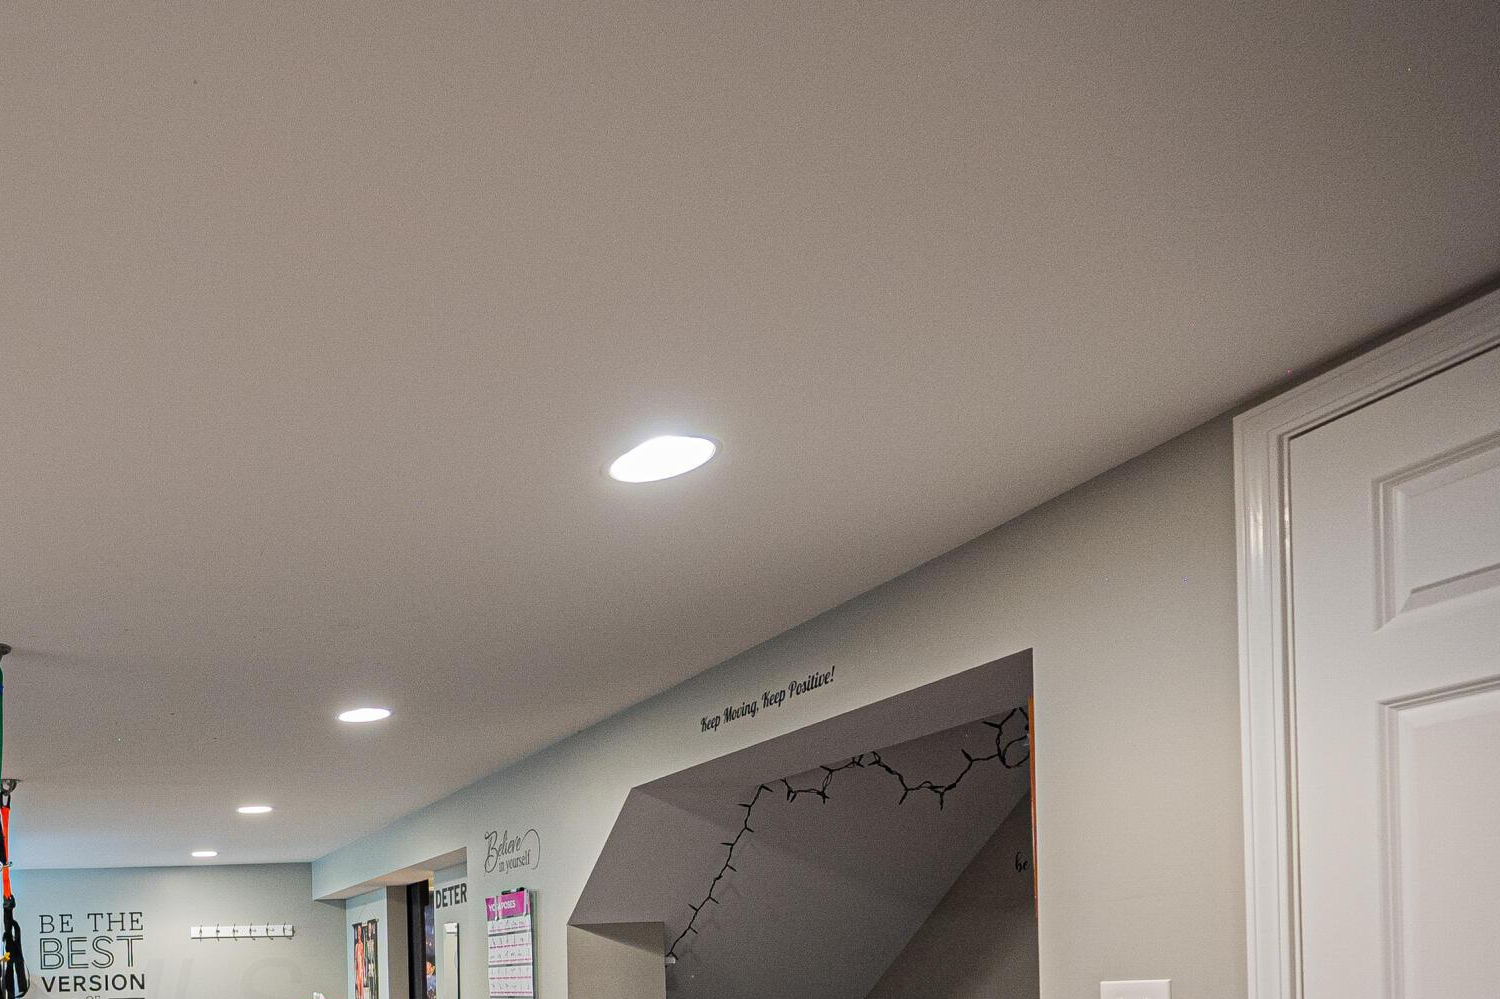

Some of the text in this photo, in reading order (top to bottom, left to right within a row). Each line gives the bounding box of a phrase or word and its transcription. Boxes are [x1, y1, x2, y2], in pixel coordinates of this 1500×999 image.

[700, 665, 836, 733] Keep Moving, Keep Positive!
[498, 849, 532, 874] in yourself
[436, 883, 467, 909] DETER
[39, 912, 144, 934] BE THE
[39, 935, 144, 970] BEST
[41, 973, 145, 993] VERSION
